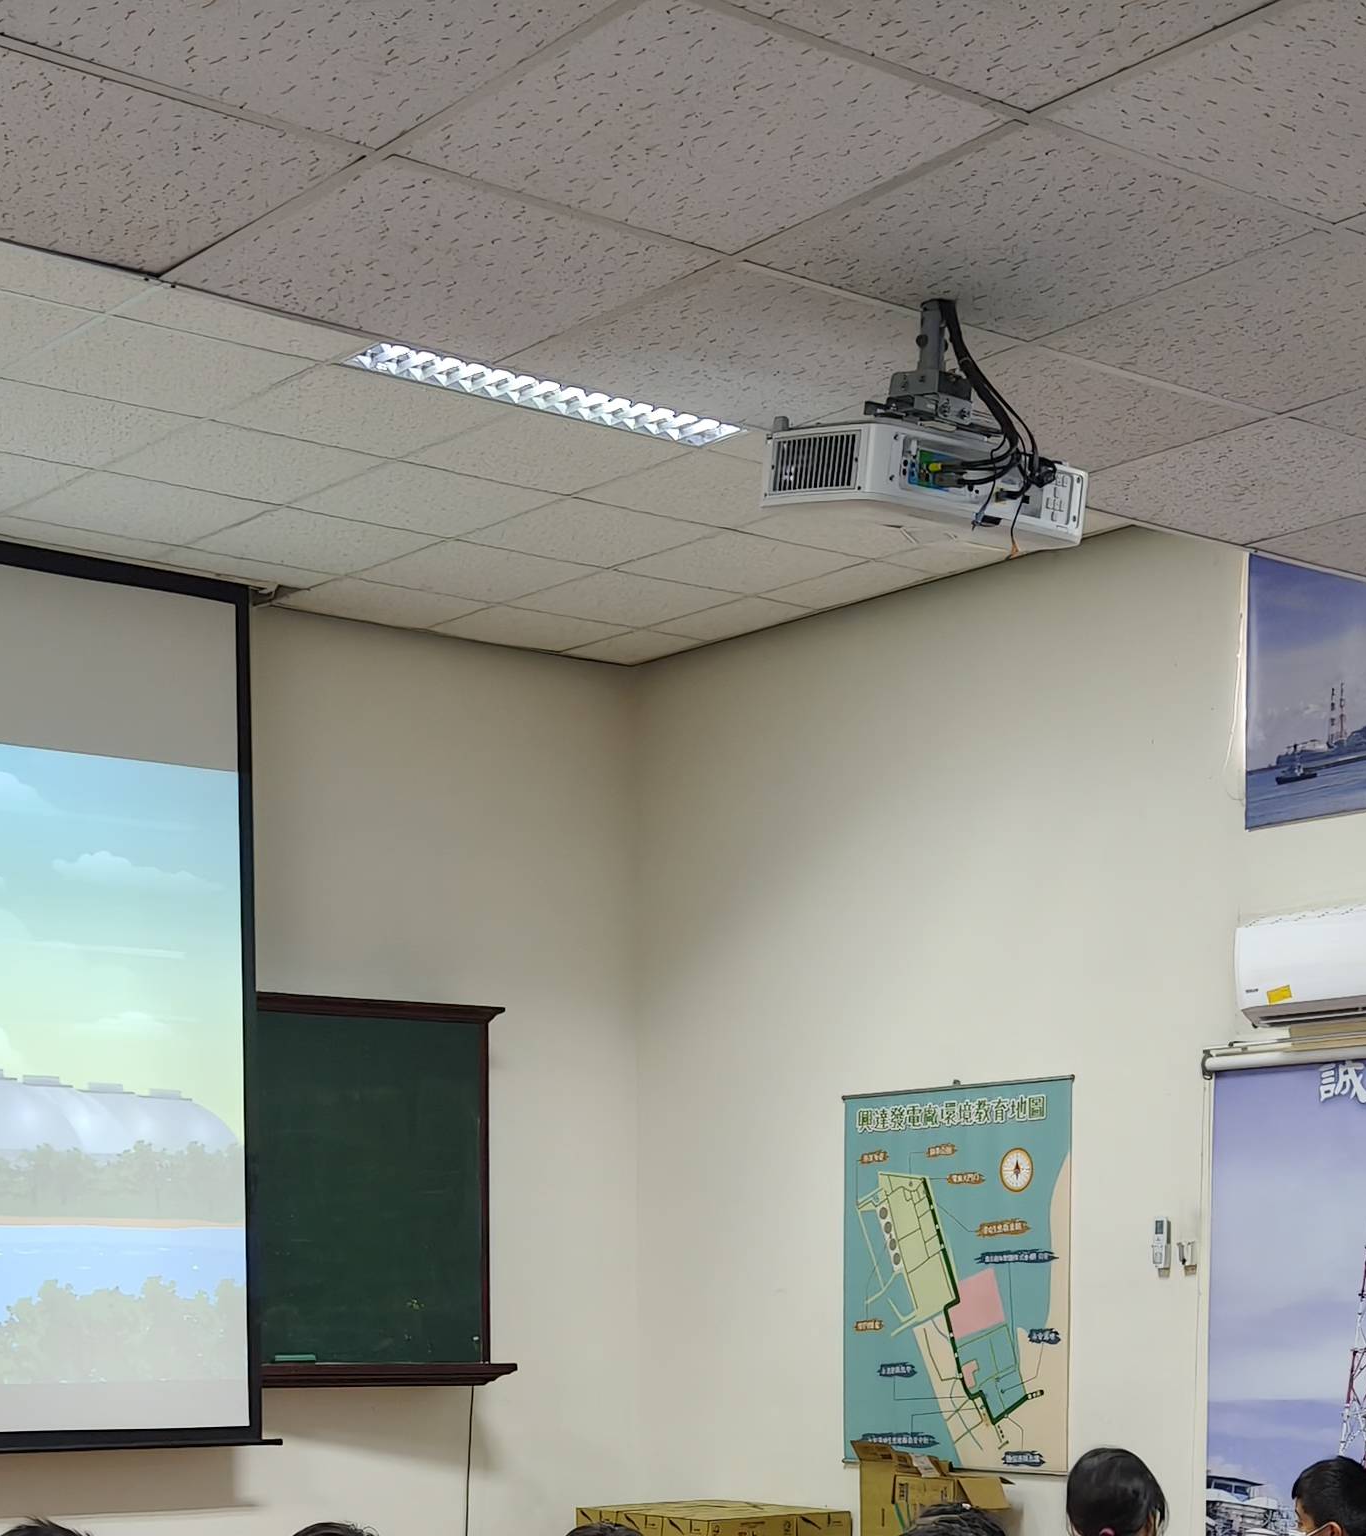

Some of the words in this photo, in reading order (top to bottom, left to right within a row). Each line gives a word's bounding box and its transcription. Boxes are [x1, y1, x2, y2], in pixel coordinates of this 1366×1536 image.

[856, 1094, 1046, 1132] 興達發電廠環境教育地圖
